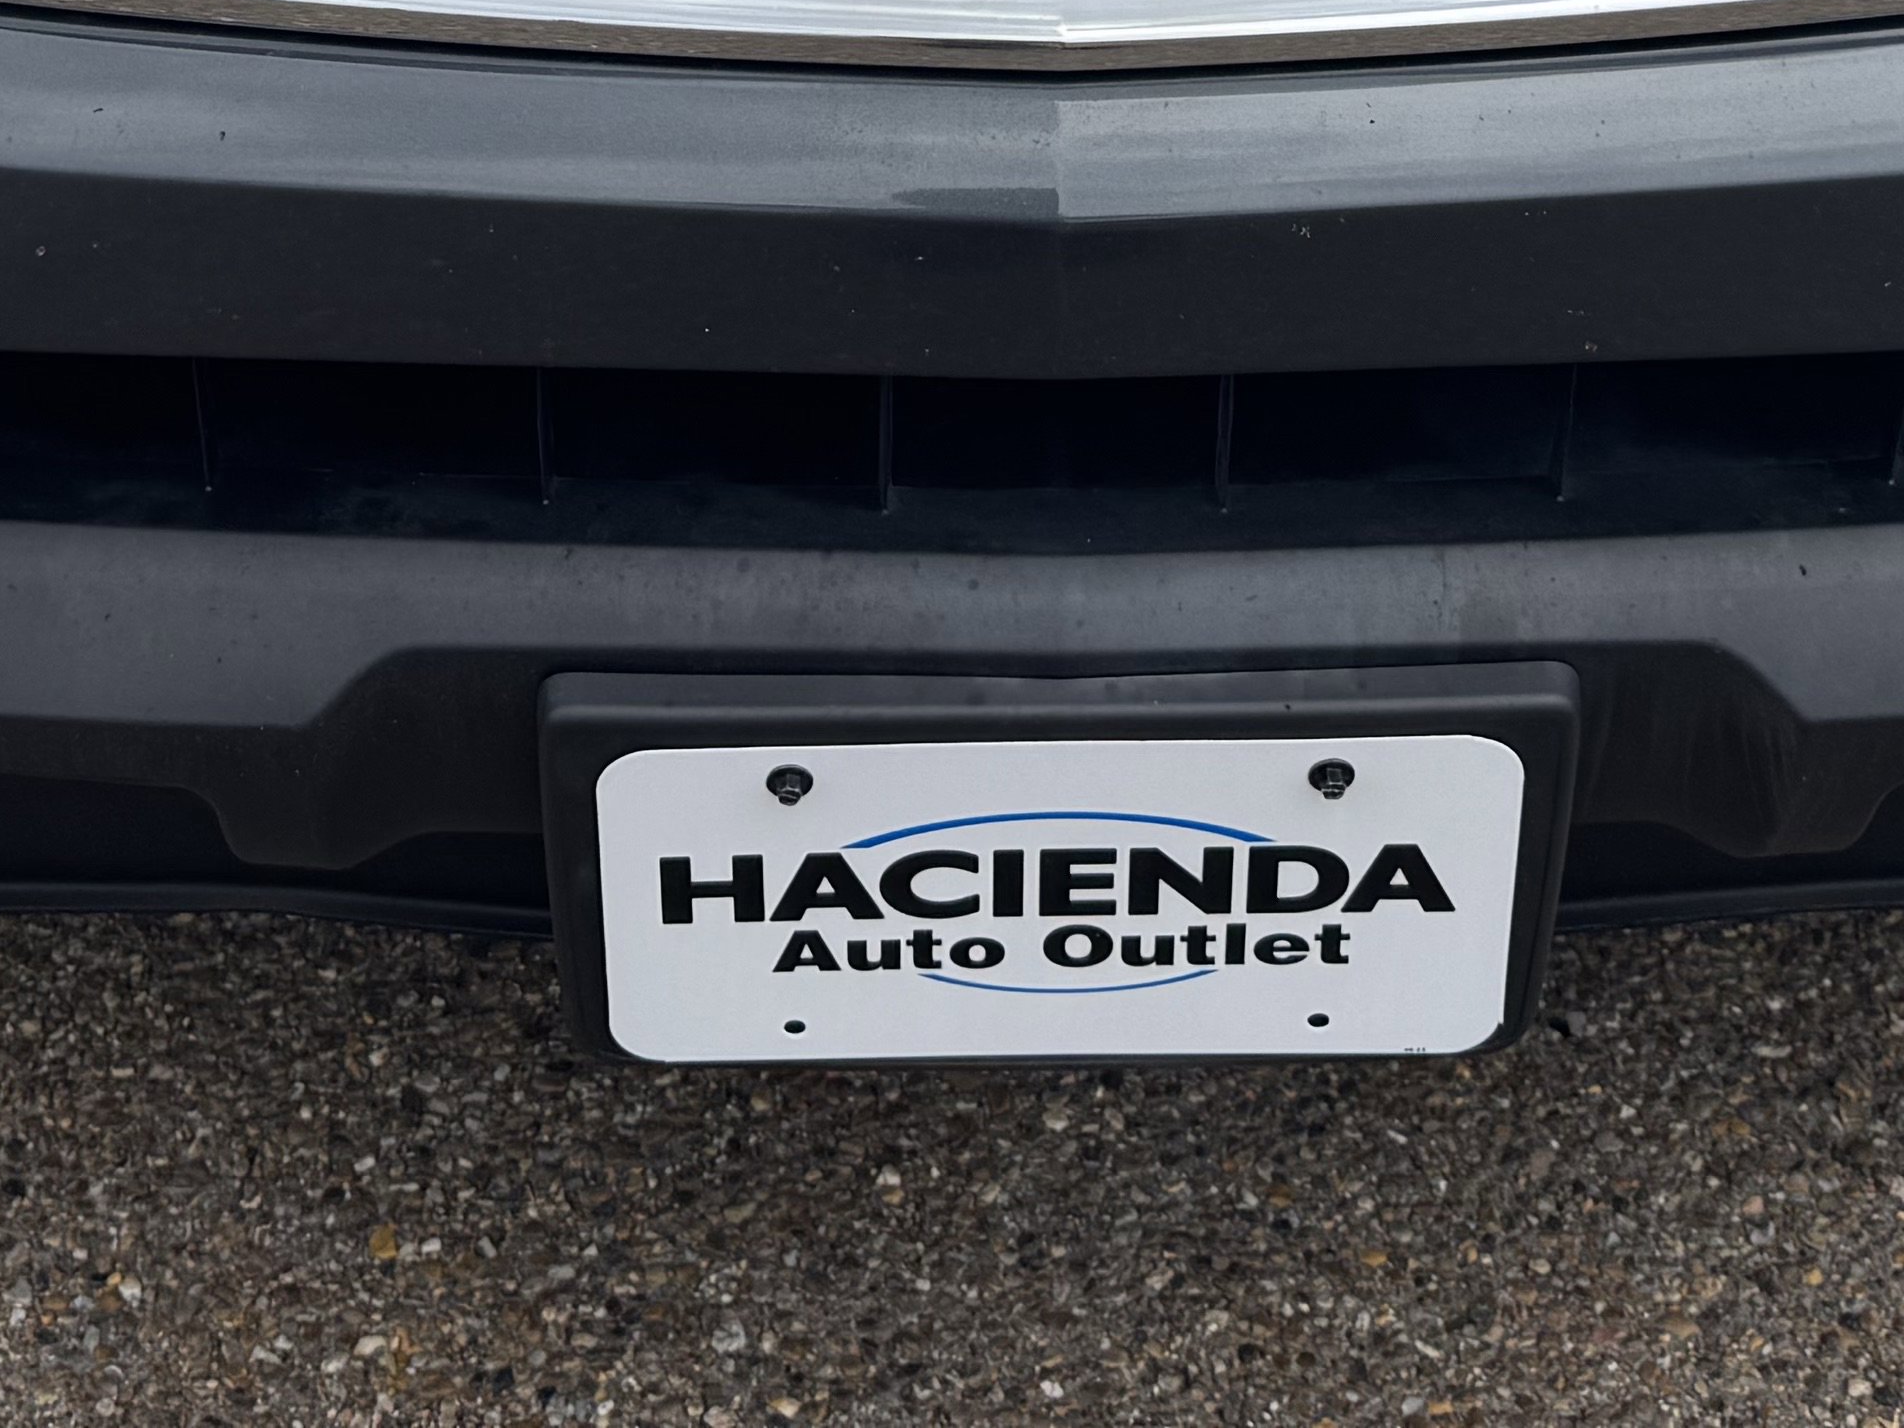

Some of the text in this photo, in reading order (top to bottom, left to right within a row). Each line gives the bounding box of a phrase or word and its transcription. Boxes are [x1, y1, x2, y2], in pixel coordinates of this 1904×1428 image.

[658, 843, 1457, 925] HACIENDA
[772, 924, 1352, 974] Auto Outlet
